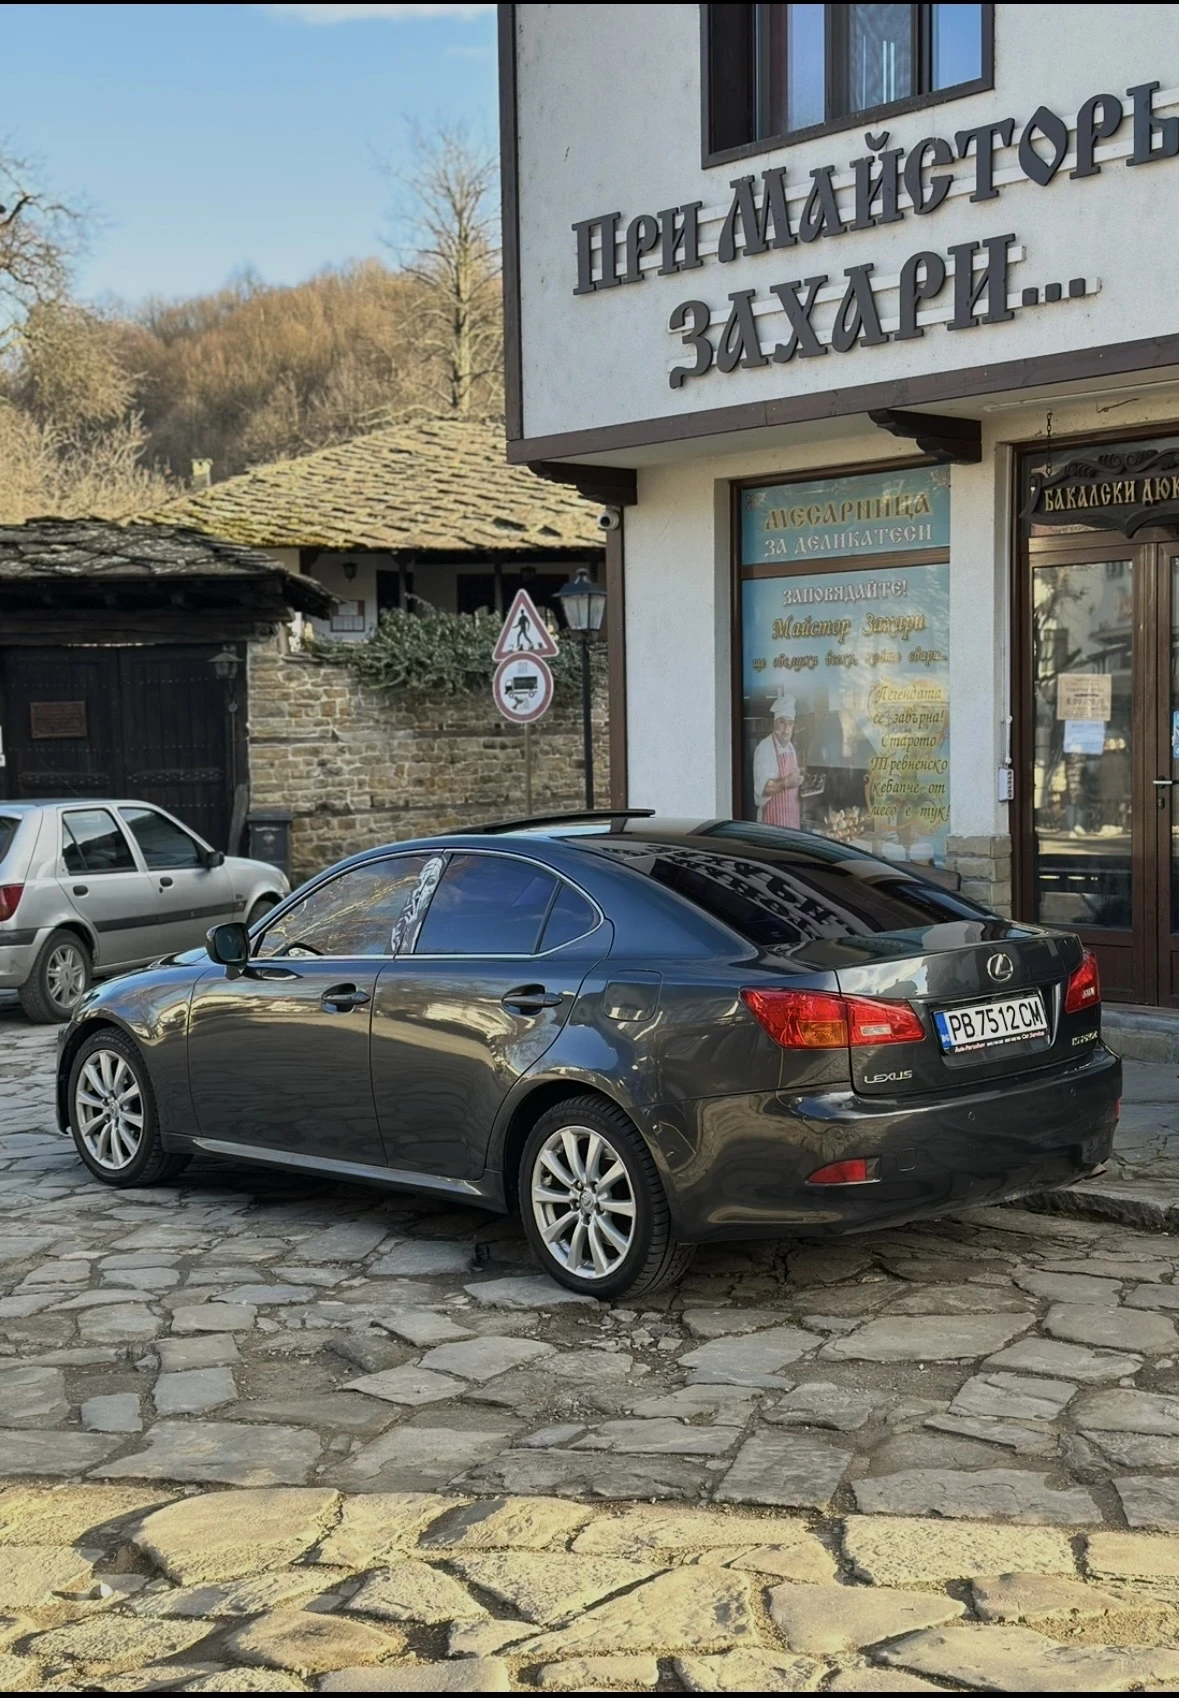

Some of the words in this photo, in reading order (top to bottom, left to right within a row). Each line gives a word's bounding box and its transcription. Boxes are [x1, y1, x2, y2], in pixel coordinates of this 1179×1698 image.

[572, 201, 703, 296] ПРИ
[668, 233, 1087, 390] ЗАХАРИ...
[1044, 480, 1135, 511] БАКАЛСКИ
[764, 493, 932, 530] МЕСАРНИЦА
[764, 539, 787, 557] ЗА
[794, 524, 932, 555] ДЕЛИКАТЕСИ
[783, 579, 907, 606] ЗАПОВЯДАЙТЕ!
[771, 613, 850, 643] Майстор
[862, 612, 926, 640] Захари
[874, 684, 942, 704] Легендата
[873, 713, 885, 725] се
[893, 705, 944, 729] завърна!
[881, 733, 936, 752] Старото
[871, 754, 948, 775] Тревненско
[872, 779, 919, 797] кебапче
[928, 783, 946, 794] от
[869, 805, 897, 817] месо
[904, 806, 911, 816] е
[920, 804, 950, 823] тук!
[864, 1069, 913, 1084] LEXUS
